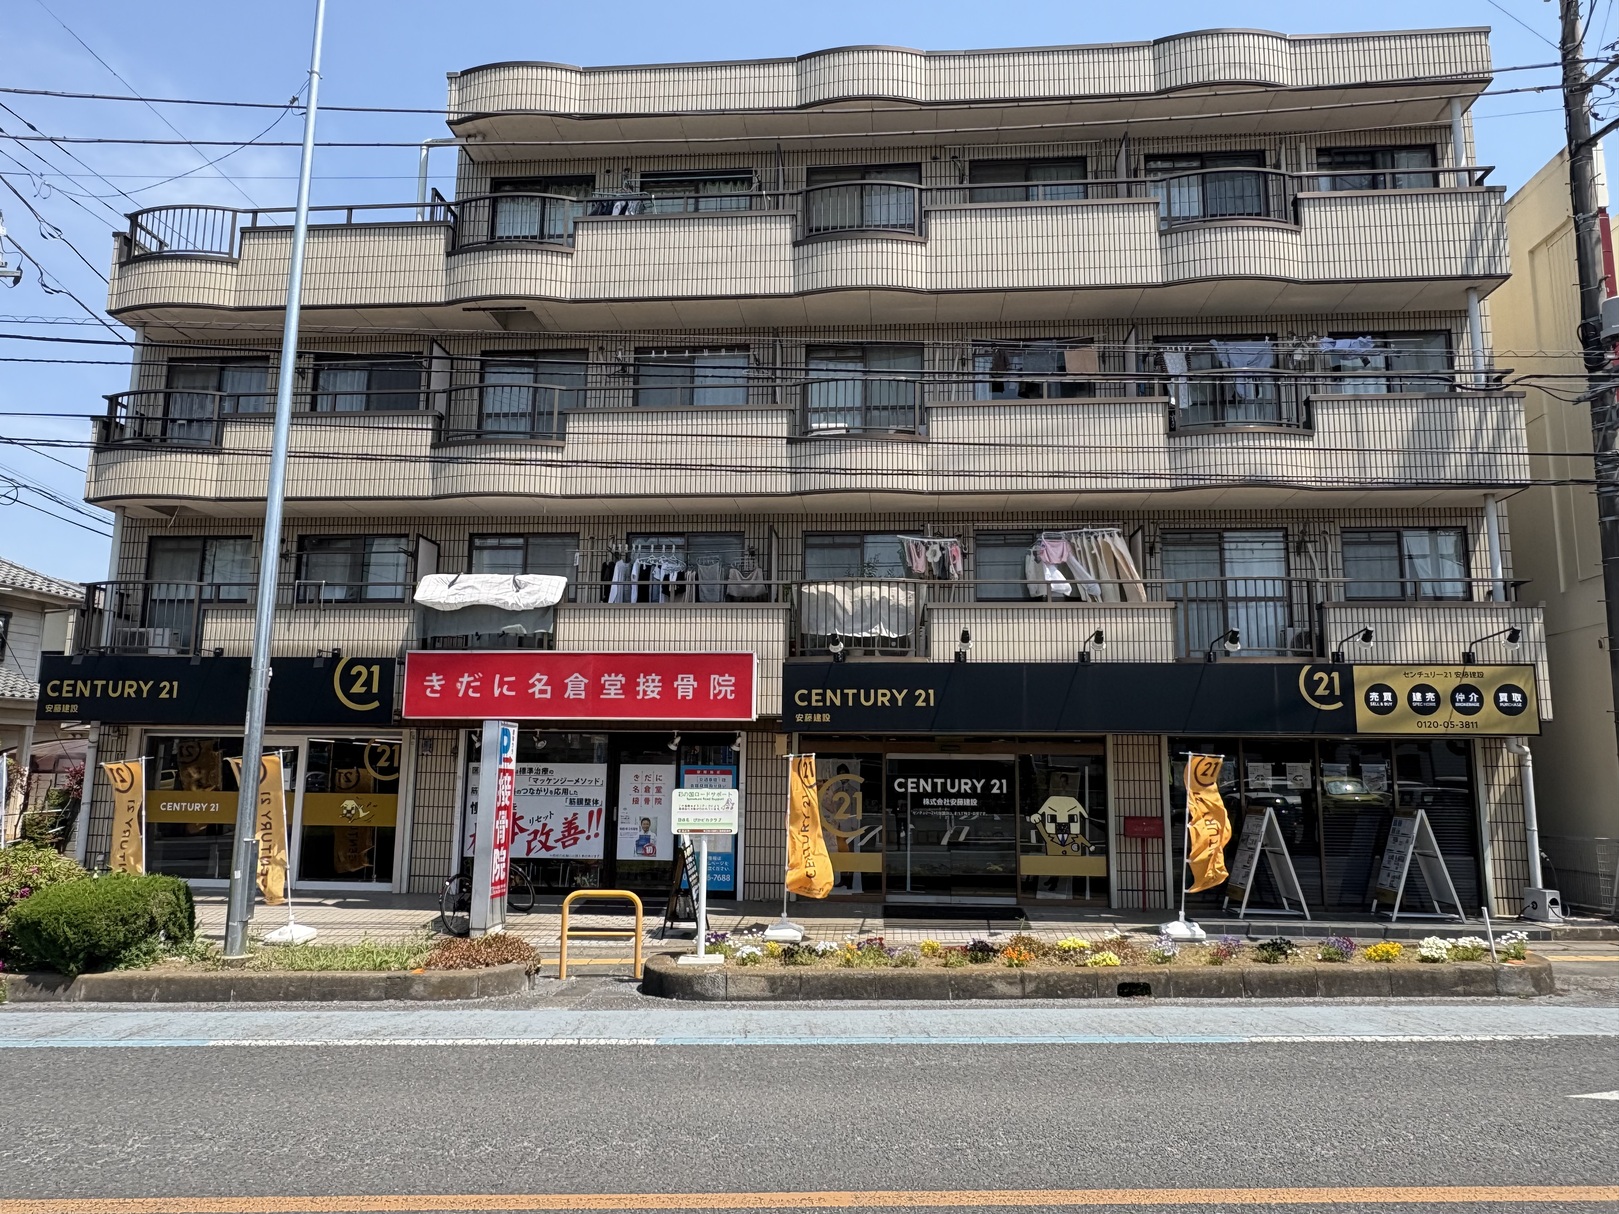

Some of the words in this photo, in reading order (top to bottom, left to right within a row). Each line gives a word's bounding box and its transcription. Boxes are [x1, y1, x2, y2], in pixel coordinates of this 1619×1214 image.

[46, 680, 154, 698] CENTURY
[158, 681, 179, 698] 21
[424, 672, 736, 700] きだに名倉堂接骨院
[794, 689, 908, 706] CENTURY
[914, 689, 935, 707] 21
[1370, 692, 1392, 702] 売買
[1412, 692, 1436, 702] 建売
[1455, 692, 1479, 702] 仲介
[1499, 692, 1522, 702] 買取
[45, 704, 78, 713] 安藤建設
[795, 714, 831, 722] 安藤建設
[894, 778, 986, 793] CENTURY
[990, 779, 1007, 793] 21
[160, 802, 208, 812] CENTURY
[210, 803, 219, 812] 21
[923, 798, 978, 806] 株式会社安藤建設
[529, 811, 554, 825] リセット
[492, 773, 511, 882] 接骨院
